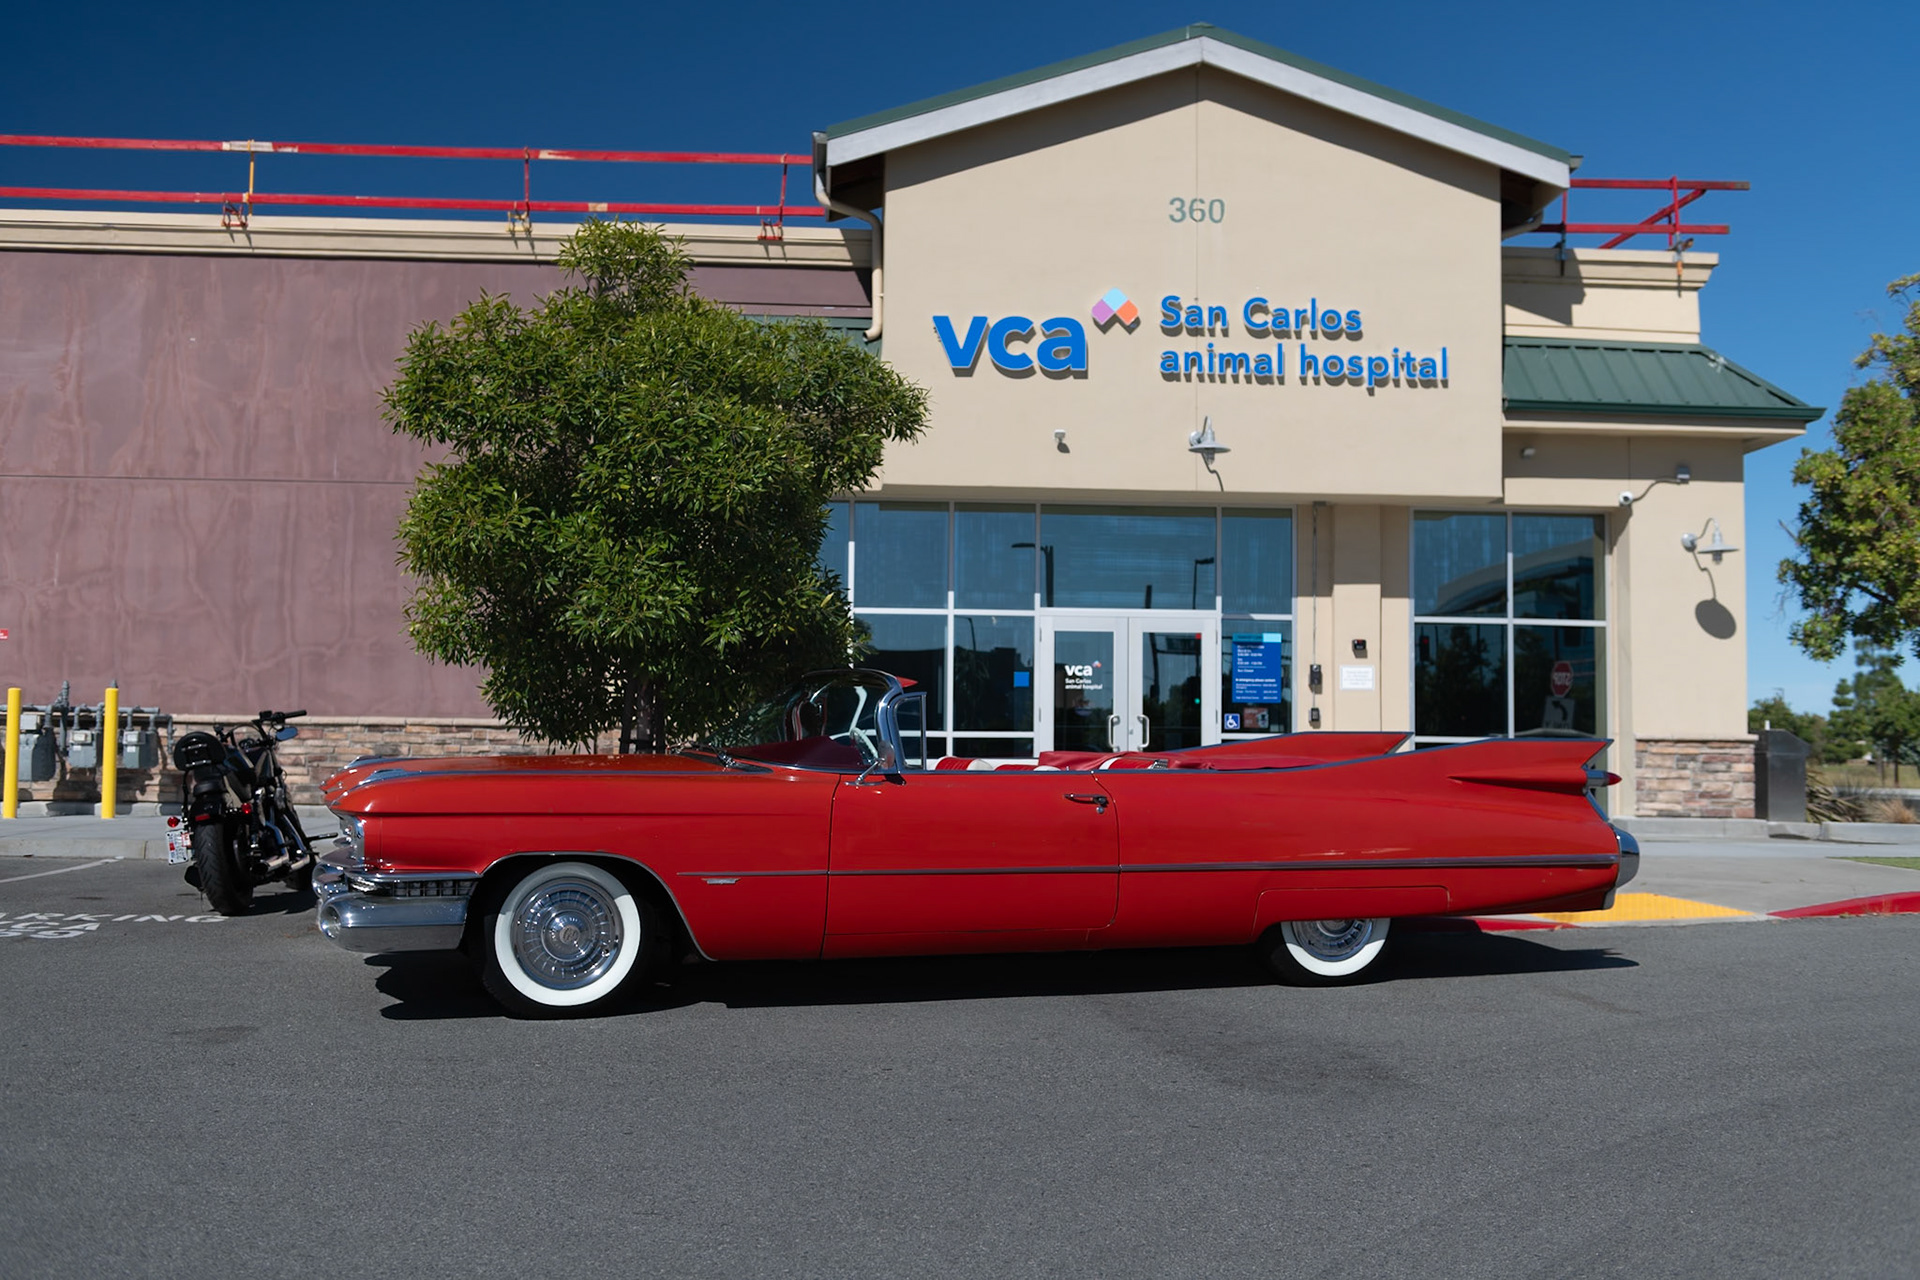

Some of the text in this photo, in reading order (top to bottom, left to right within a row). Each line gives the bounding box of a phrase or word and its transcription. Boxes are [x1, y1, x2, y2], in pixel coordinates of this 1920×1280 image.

[1169, 197, 1225, 224] 360
[1160, 294, 1363, 333] San Carlos
[932, 315, 1087, 371] vca
[1159, 343, 1449, 388] animal hospital
[1064, 665, 1093, 677] vca
[0, 912, 229, 922] RKING
